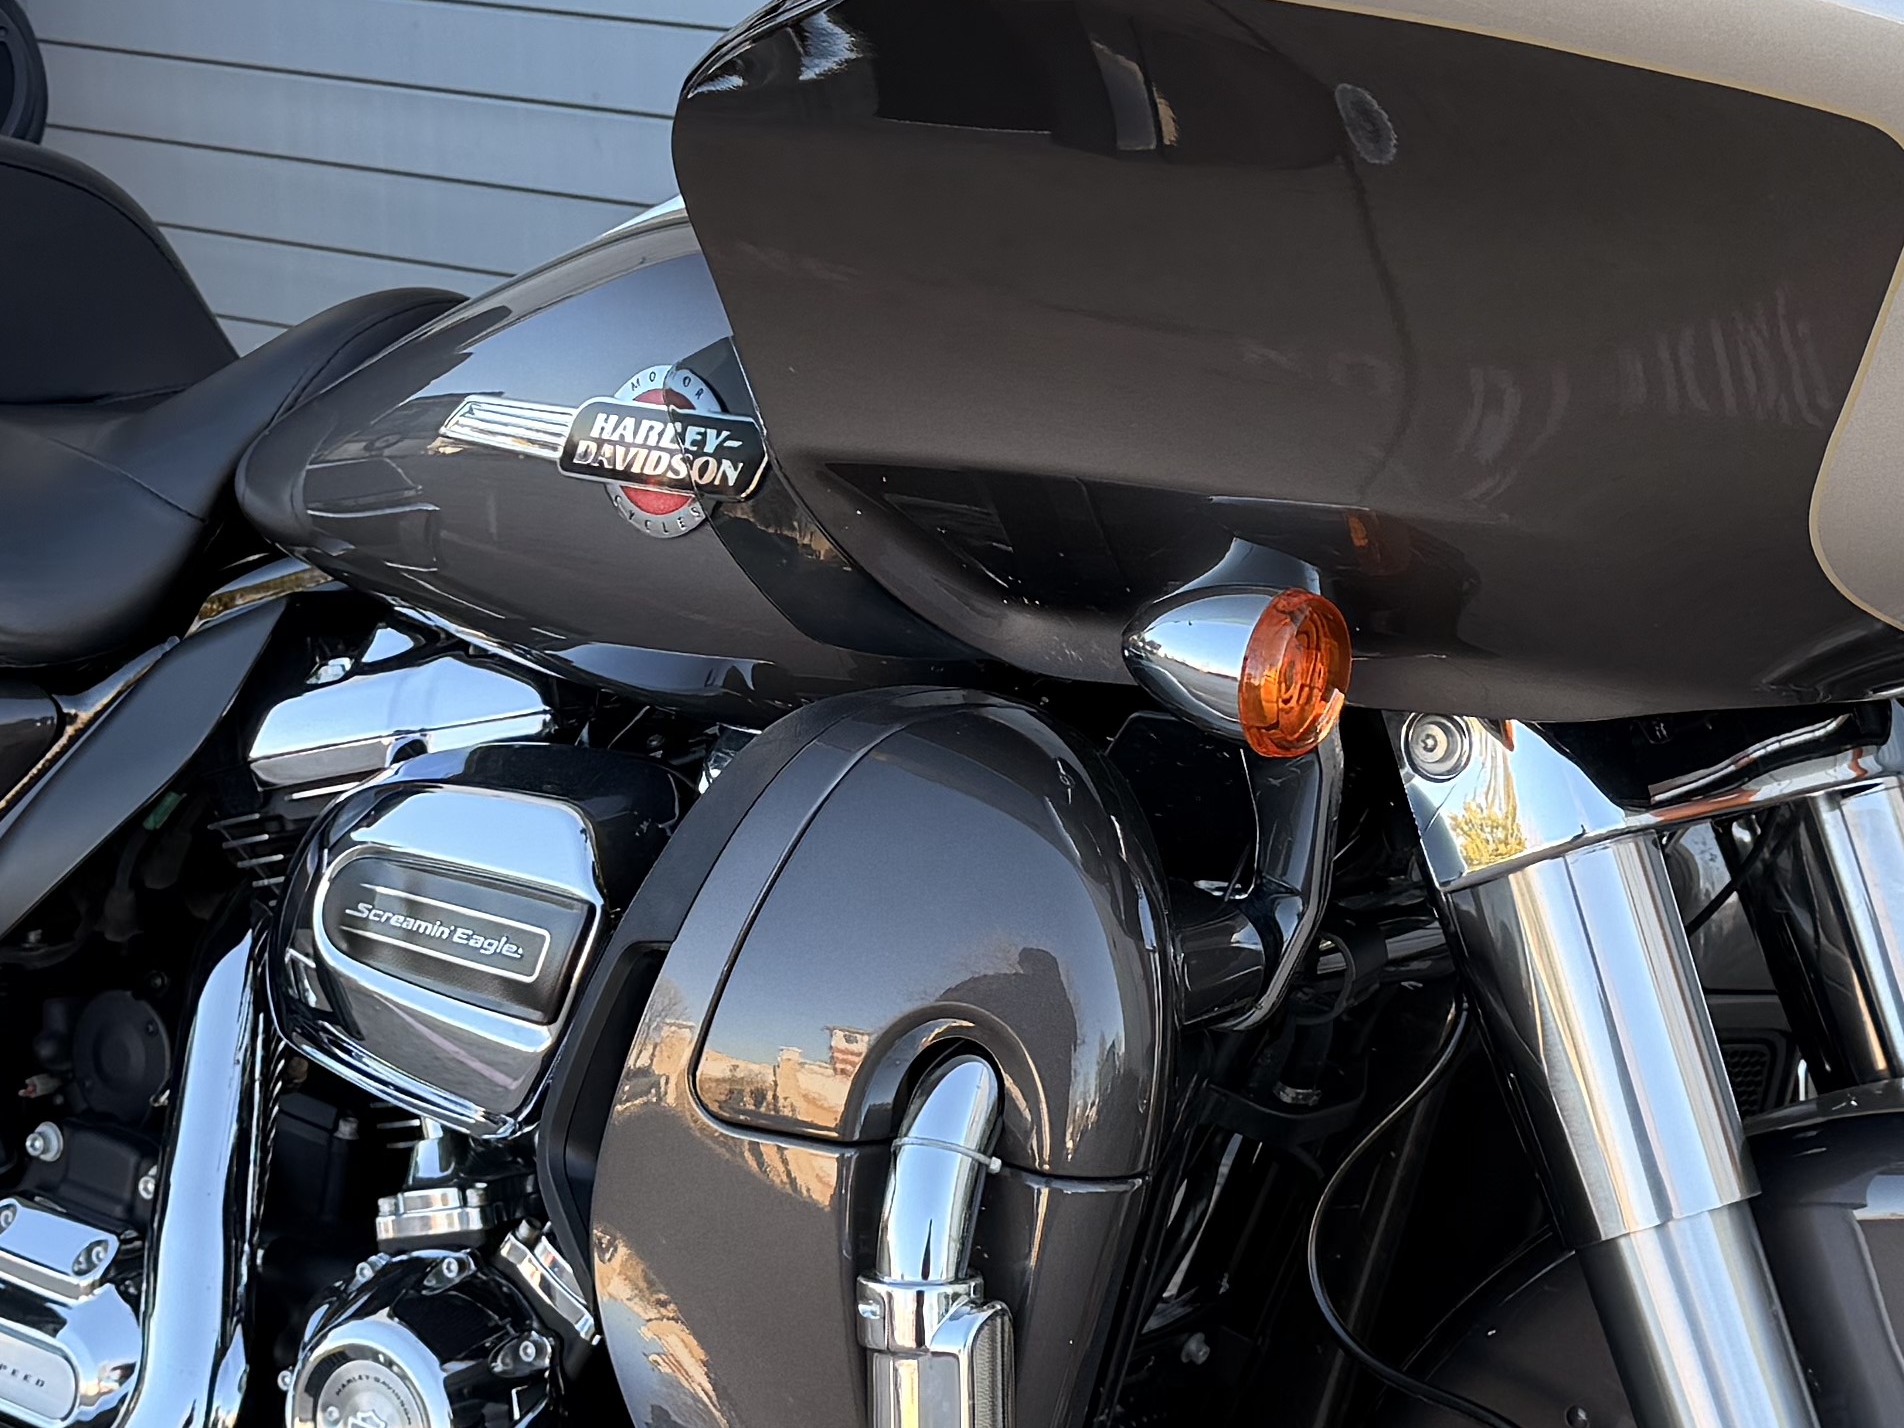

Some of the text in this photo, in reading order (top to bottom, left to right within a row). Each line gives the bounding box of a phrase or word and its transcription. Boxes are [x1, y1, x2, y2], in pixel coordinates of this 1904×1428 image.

[630, 371, 704, 400] MOOR
[589, 412, 743, 454] HARLEY-
[573, 440, 744, 487] DAVIDSON
[614, 494, 701, 534] CYCLES
[452, 927, 523, 959] Eagle
